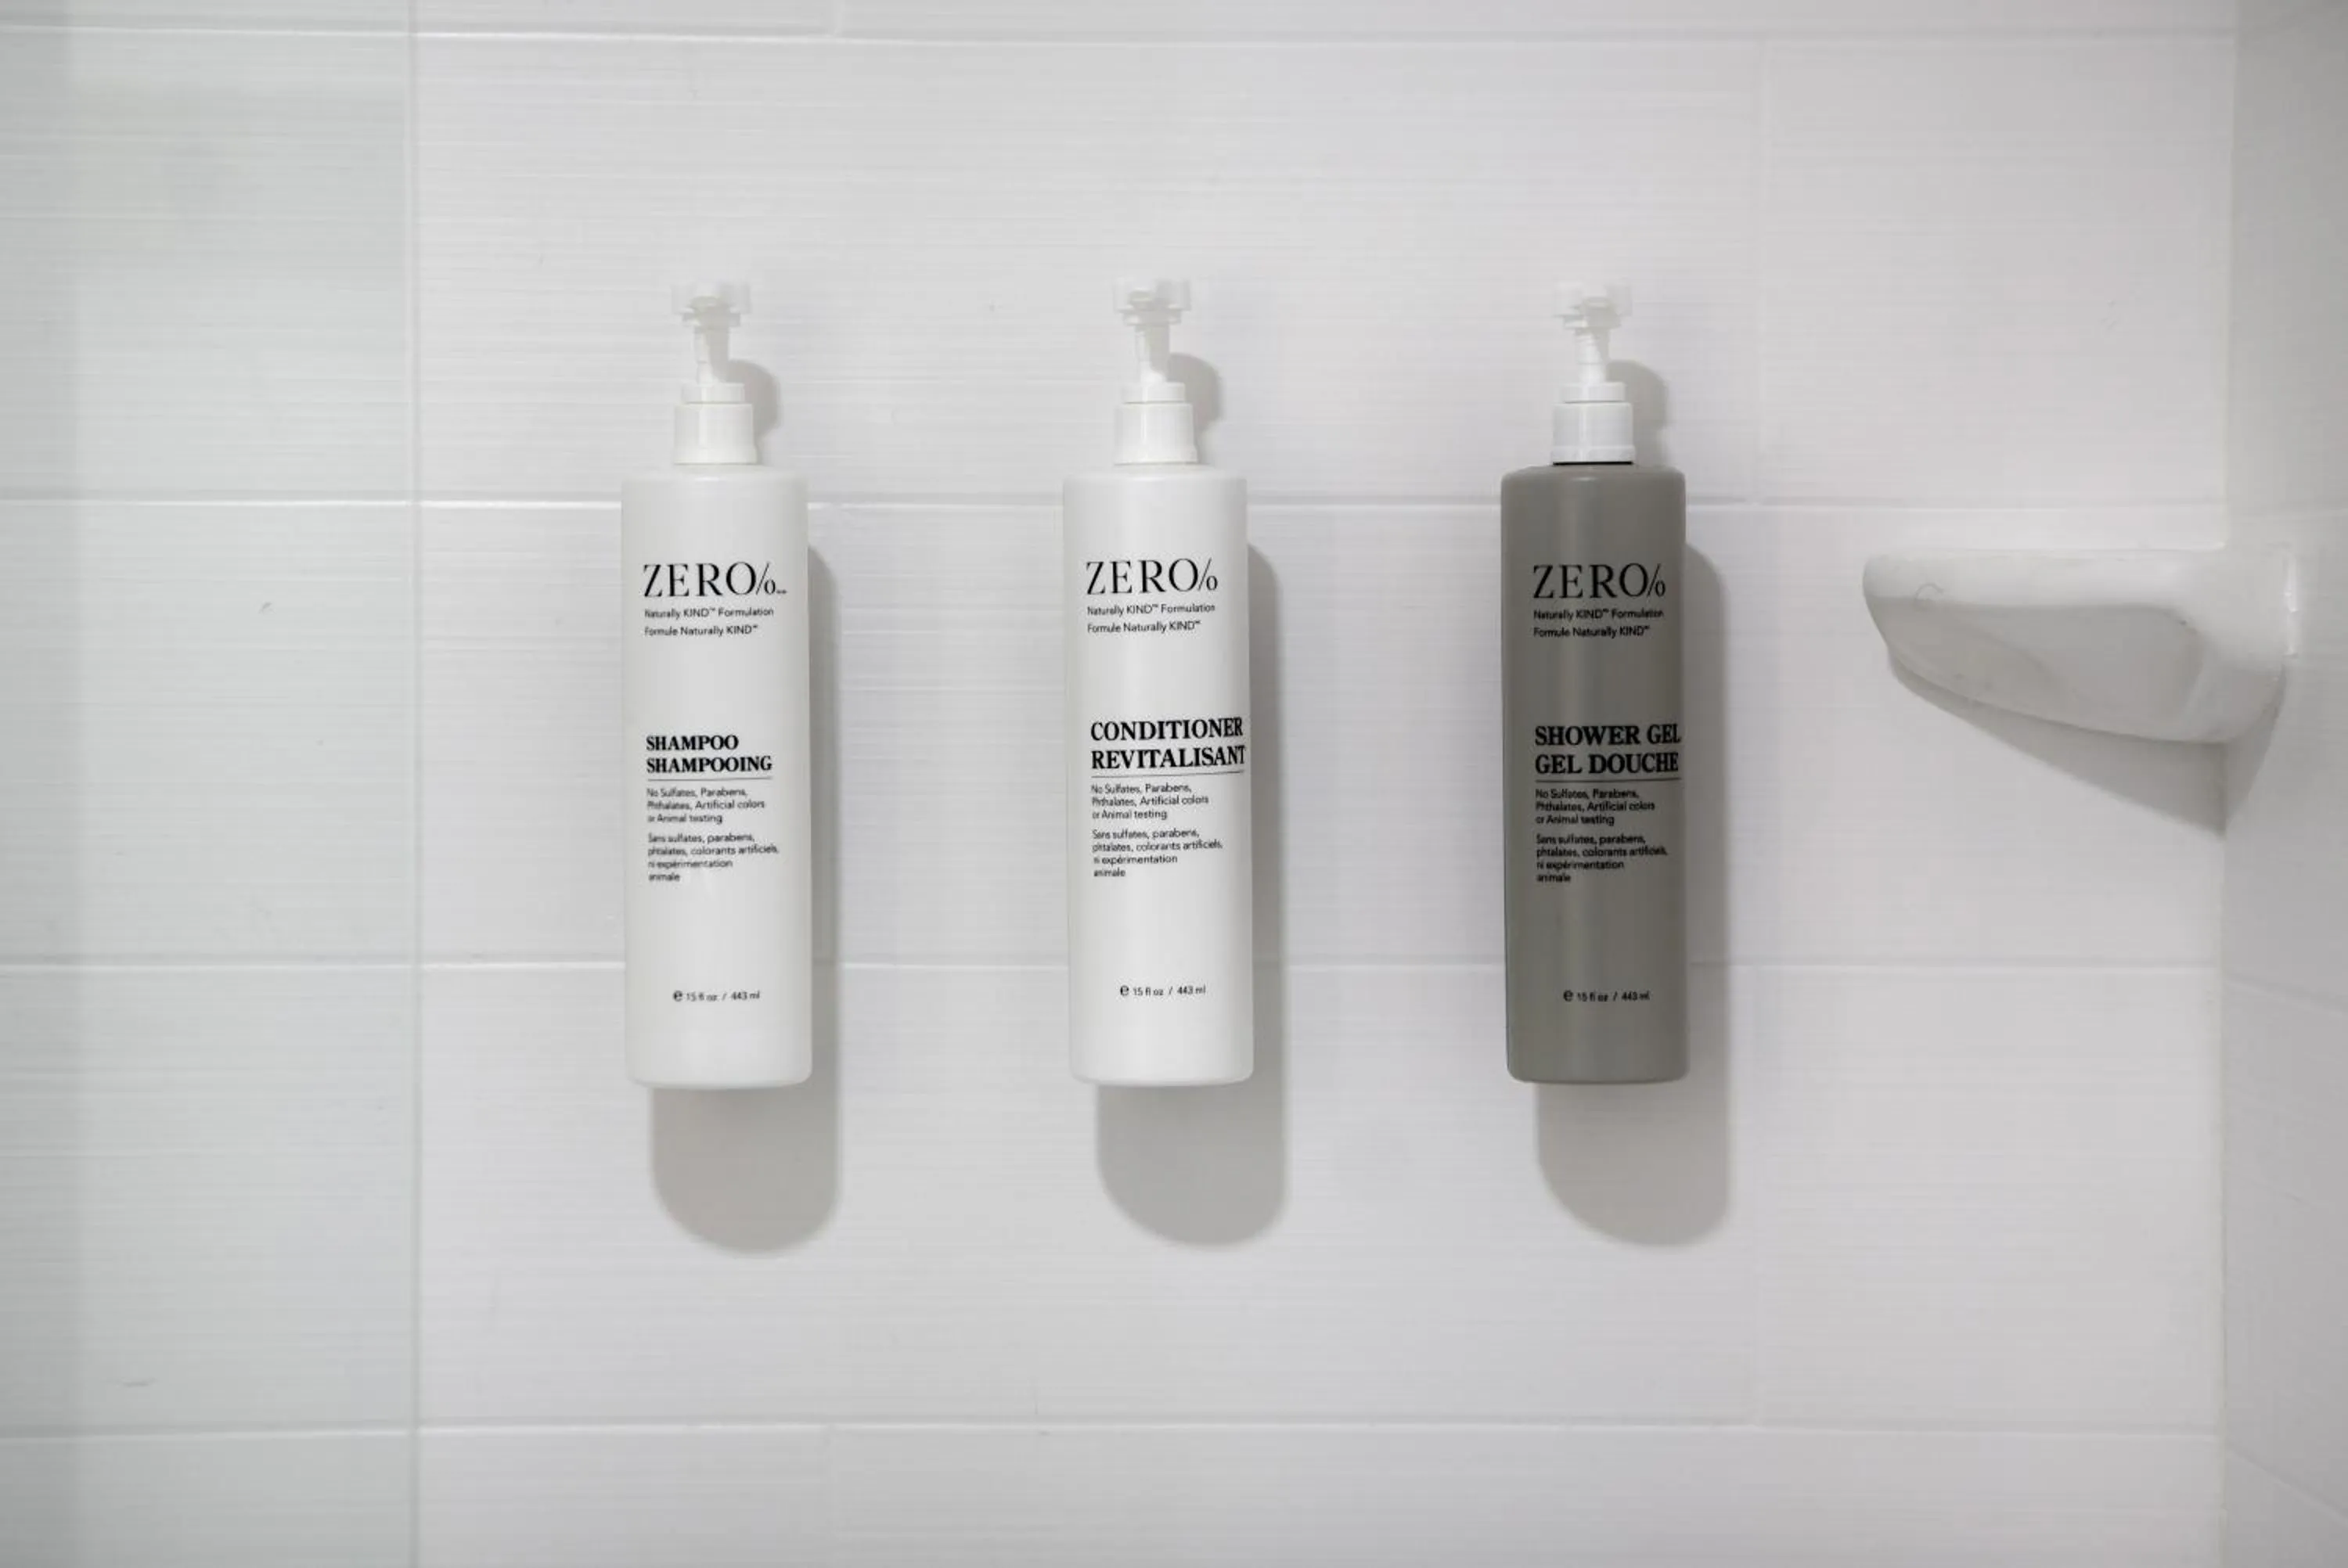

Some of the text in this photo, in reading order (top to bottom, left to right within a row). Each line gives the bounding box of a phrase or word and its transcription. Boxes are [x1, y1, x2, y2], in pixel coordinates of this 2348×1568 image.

[644, 609, 681, 620] Naturally
[718, 607, 773, 617] Formulation
[1087, 606, 1124, 617] Naturally
[1161, 603, 1215, 613] Formulation
[1533, 610, 1574, 620] Naturally
[1612, 608, 1664, 618] Formulation
[644, 627, 679, 636] Formule
[680, 626, 724, 637] Naturally
[1087, 624, 1122, 633] Formule
[1123, 622, 1167, 634] Naturally
[1533, 628, 1570, 638] Formule
[1572, 627, 1617, 638] Naturally
[1090, 717, 1243, 741] CONDITIONER
[1535, 724, 1681, 746] SHOWER GEL
[646, 735, 739, 750] SHAMPOO
[1091, 745, 1245, 769] REVITALISANT
[646, 756, 772, 773] SHAMPOOING
[1536, 753, 1679, 774] GEL DOUCHE
[700, 787, 748, 797] Parabens,
[1091, 785, 1103, 793] No
[1145, 782, 1192, 793] Parabens,
[1536, 789, 1548, 798] No
[1593, 789, 1639, 798] Parabens,
[695, 800, 735, 809] Artificial
[1140, 797, 1179, 805] Artificial
[1182, 795, 1209, 804] colors
[1587, 801, 1627, 811] Artificial
[1630, 801, 1655, 810] colors
[657, 814, 686, 822] Animal
[690, 814, 723, 825] testing
[1102, 810, 1132, 819] Animal
[1134, 810, 1168, 820] testing
[1546, 815, 1579, 824] Animal
[1581, 815, 1615, 825] testing
[648, 833, 665, 843] Sans
[707, 833, 754, 843] parabens,
[1092, 830, 1110, 839] Sans
[1152, 829, 1199, 839] parabens,
[1536, 834, 1556, 843] Sans
[1599, 833, 1646, 844] parabens,
[691, 847, 736, 855] colorants
[1136, 842, 1180, 851] colorants
[1583, 847, 1627, 856] colorants
[649, 872, 680, 881] animale
[1094, 869, 1125, 877] animale
[1133, 987, 1143, 996] 15
[1177, 986, 1193, 994] 443
[1195, 984, 1206, 994] ml
[686, 992, 697, 1002] 15
[731, 991, 747, 1000] 443
[750, 991, 760, 1000] ml
[1577, 992, 1587, 1002] 15
[1622, 991, 1637, 1001] 443
[1640, 991, 1650, 1000] ml
